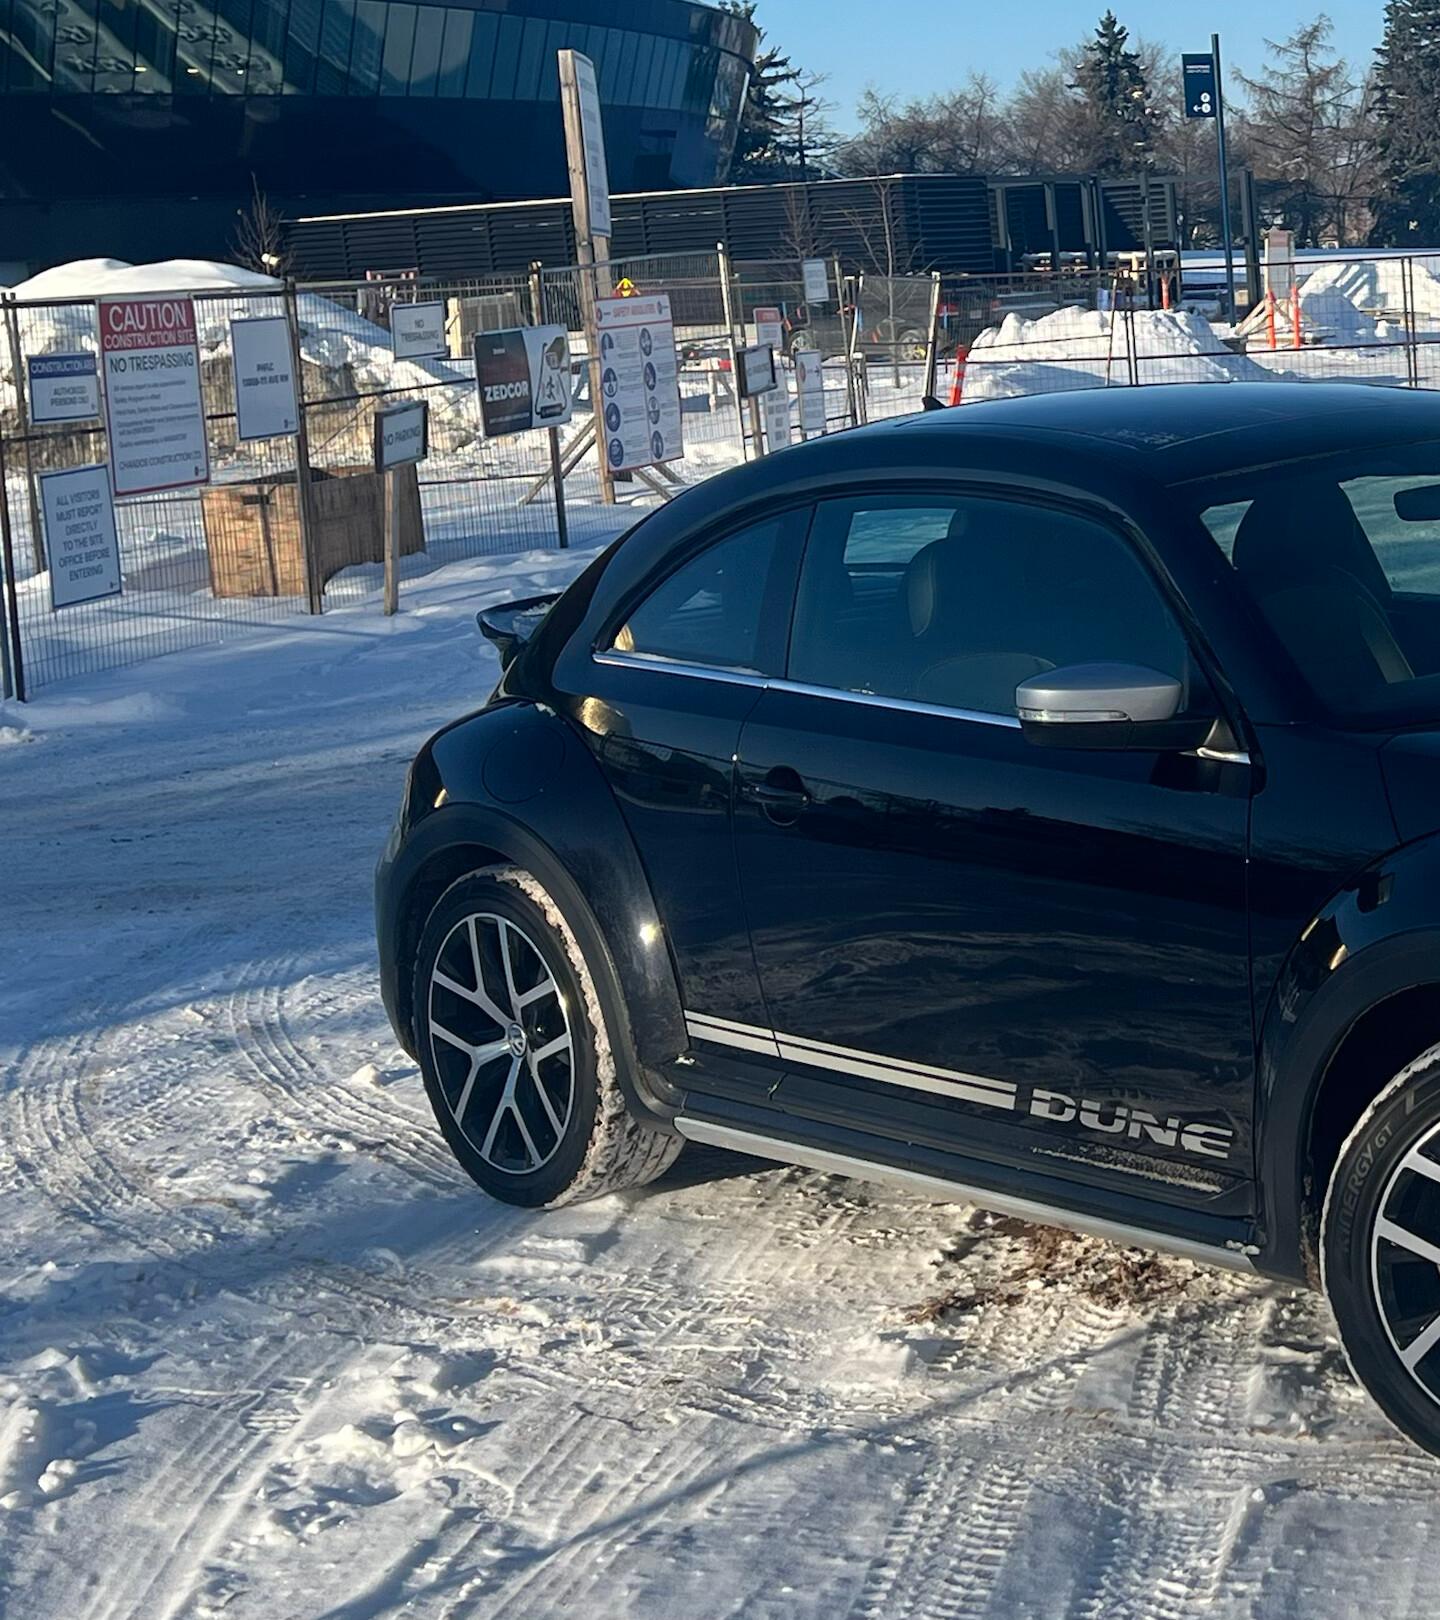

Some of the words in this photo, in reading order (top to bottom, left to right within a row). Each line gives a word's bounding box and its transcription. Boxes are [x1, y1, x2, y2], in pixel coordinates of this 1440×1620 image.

[109, 302, 187, 332] CAUTION
[104, 330, 177, 349] CONSTRUCTION
[177, 328, 195, 343] SITE
[110, 357, 127, 373] NO
[128, 351, 194, 371] TRESPASSING
[484, 381, 529, 402] ZEDCOR
[384, 432, 394, 446] NO
[56, 509, 76, 522] MUST
[77, 503, 103, 518] REPORT
[65, 520, 98, 536] DIRECTLY
[63, 540, 74, 552] TO
[75, 536, 88, 548] THE
[1030, 1088, 1233, 1159] DUNE
[1375, 1121, 1393, 1149] GT
